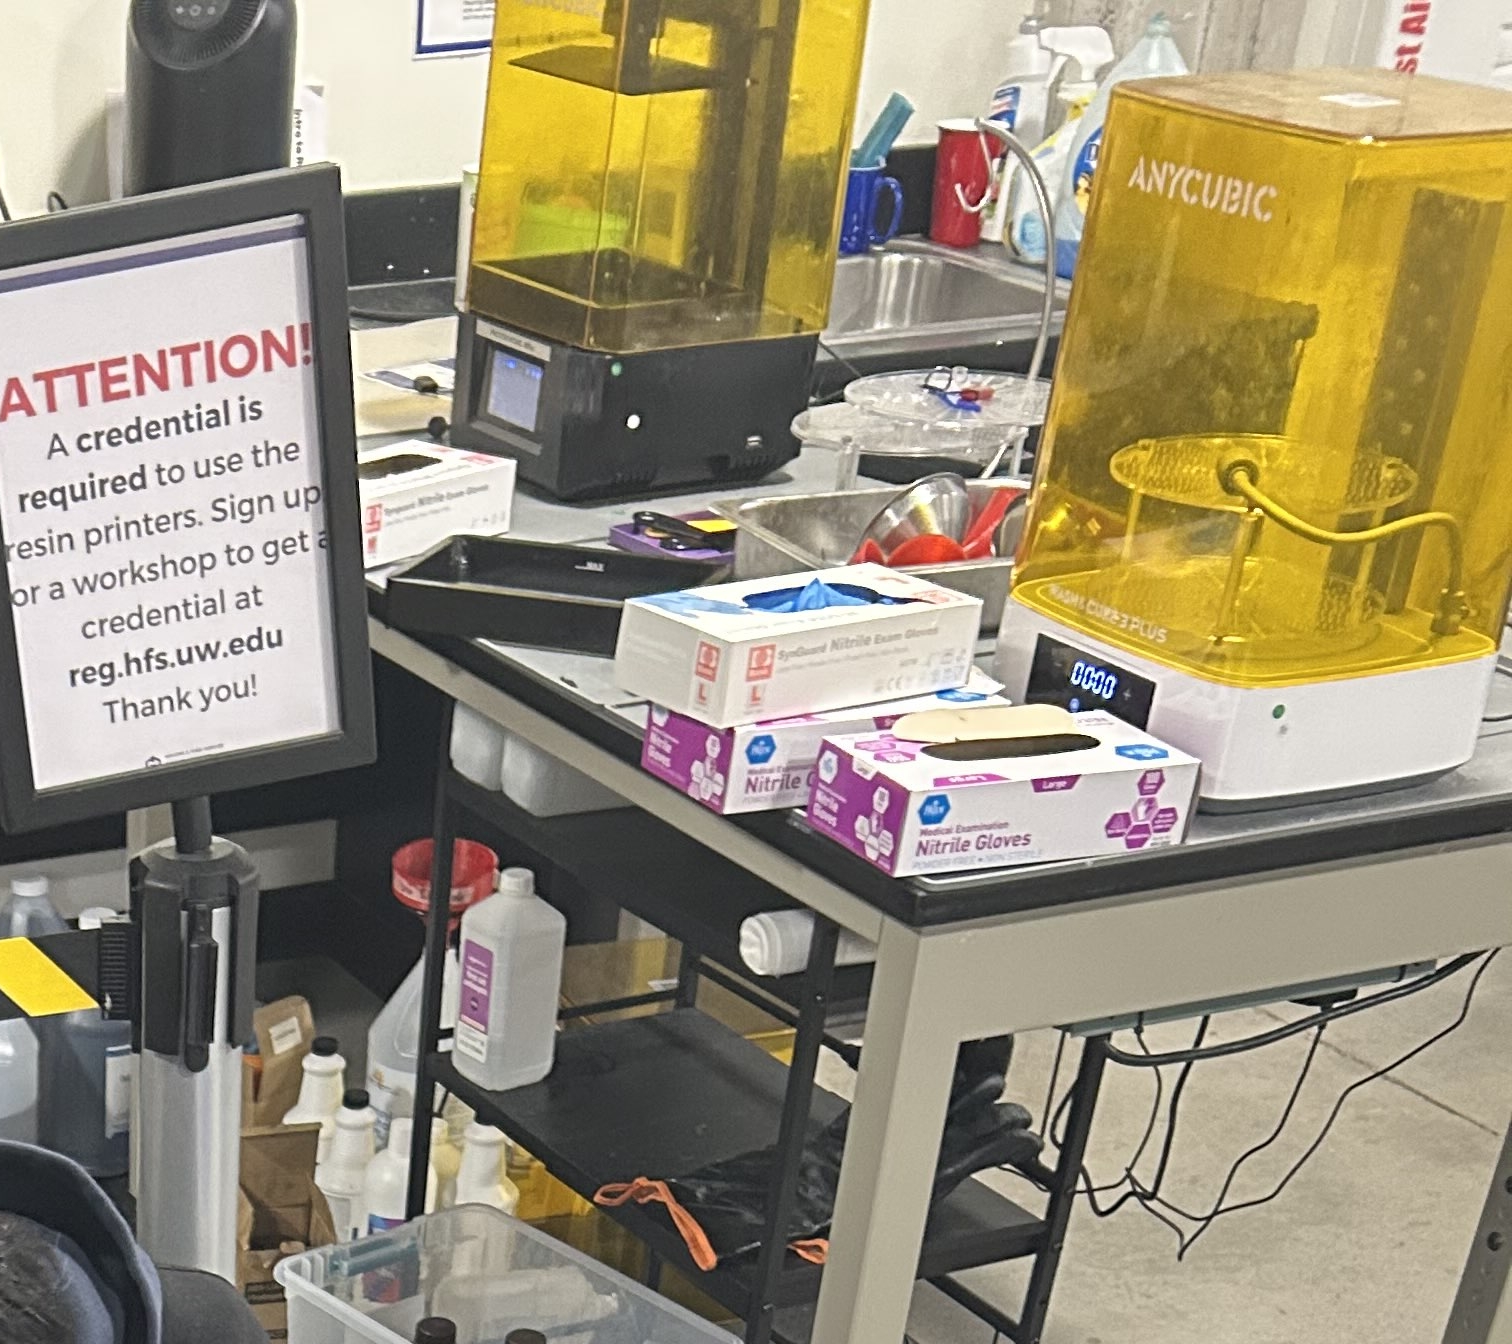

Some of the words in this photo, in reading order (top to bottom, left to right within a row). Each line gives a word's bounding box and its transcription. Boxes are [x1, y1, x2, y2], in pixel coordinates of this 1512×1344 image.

[1128, 155, 1277, 222] ANYCUBIC
[46, 433, 70, 460] A
[76, 399, 231, 454] credential
[239, 395, 263, 423] is
[18, 463, 147, 513] required
[155, 463, 185, 486] to
[194, 452, 243, 479] use
[251, 440, 300, 468] the
[5, 528, 75, 562] resin
[84, 508, 203, 554] printers.
[211, 493, 275, 524] Sign
[283, 485, 321, 512] up
[11, 584, 41, 607] or
[49, 581, 66, 600] a
[72, 552, 217, 596] workshop
[224, 544, 254, 566] to
[262, 530, 310, 566] get
[81, 589, 226, 640] credential
[235, 585, 264, 610] at
[68, 626, 284, 688] reg.hfs.uw.edu
[829, 634, 872, 653] Nitrile
[102, 686, 193, 724] Thank
[198, 673, 259, 713] you!
[744, 776, 802, 795] Nitrile
[915, 836, 971, 857] Nitrile
[975, 832, 1033, 851] Gloves
[919, 827, 954, 837] Medical
[956, 821, 1010, 834] Examination
